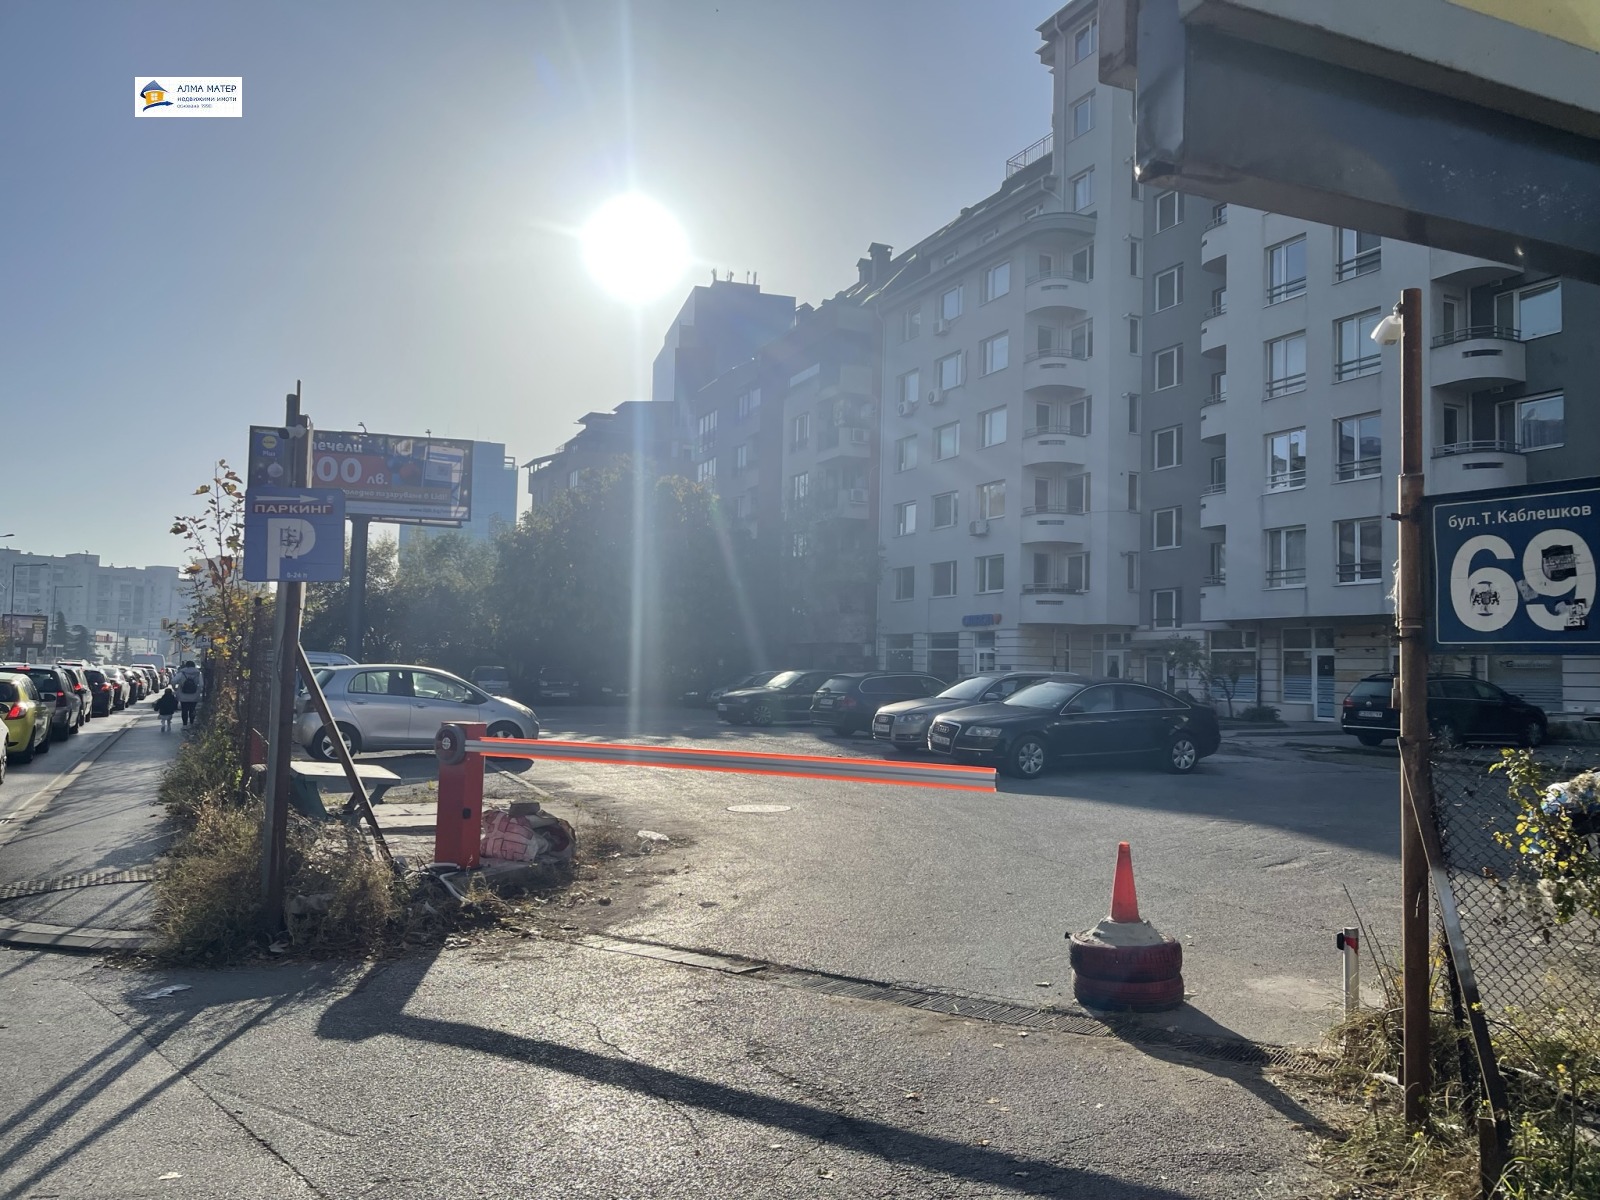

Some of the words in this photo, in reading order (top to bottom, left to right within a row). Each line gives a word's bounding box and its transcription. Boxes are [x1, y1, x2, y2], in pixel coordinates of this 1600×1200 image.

[313, 456, 363, 483] 00
[366, 472, 389, 486] лв.
[341, 488, 374, 499] оледно
[254, 504, 332, 514] ПАРКИНГ
[1448, 514, 1480, 530] бул.
[1481, 511, 1496, 525] Т.
[1497, 505, 1592, 524] Каблешков
[1450, 528, 1597, 632] 69
